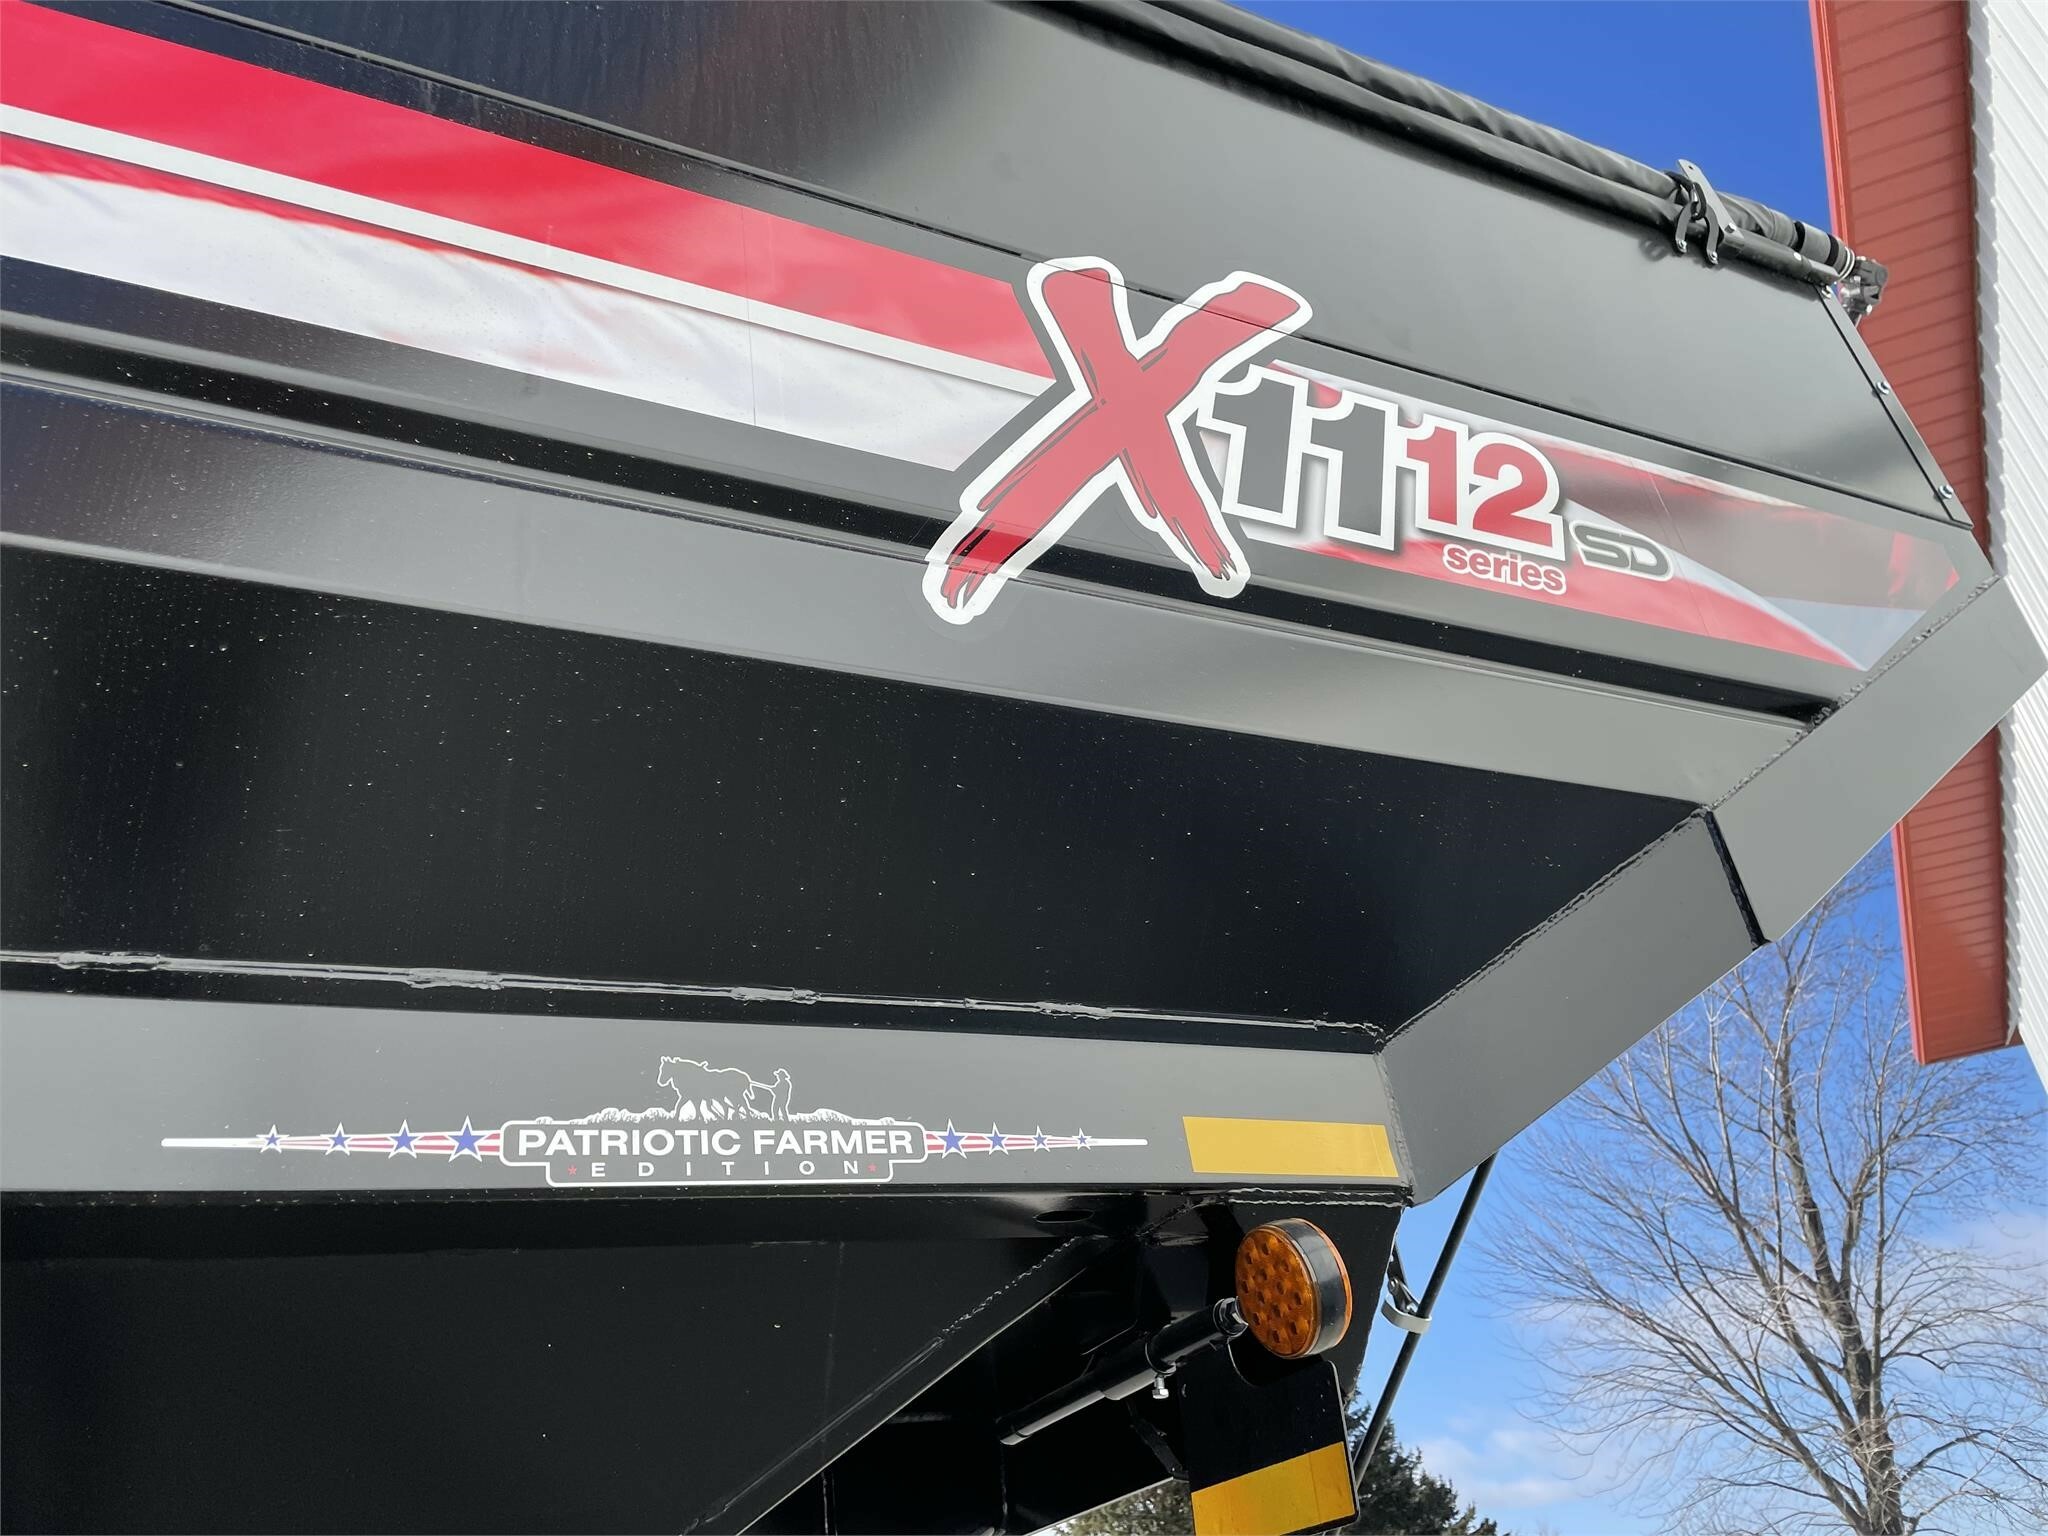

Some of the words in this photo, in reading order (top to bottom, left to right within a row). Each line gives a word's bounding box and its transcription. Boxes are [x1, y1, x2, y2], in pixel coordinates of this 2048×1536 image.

[1444, 542, 1566, 595] series
[1571, 523, 1674, 580] SD
[518, 1128, 741, 1157] PATRIOTIC
[754, 1129, 914, 1156] FARMER
[591, 1160, 860, 1178] EDITION
